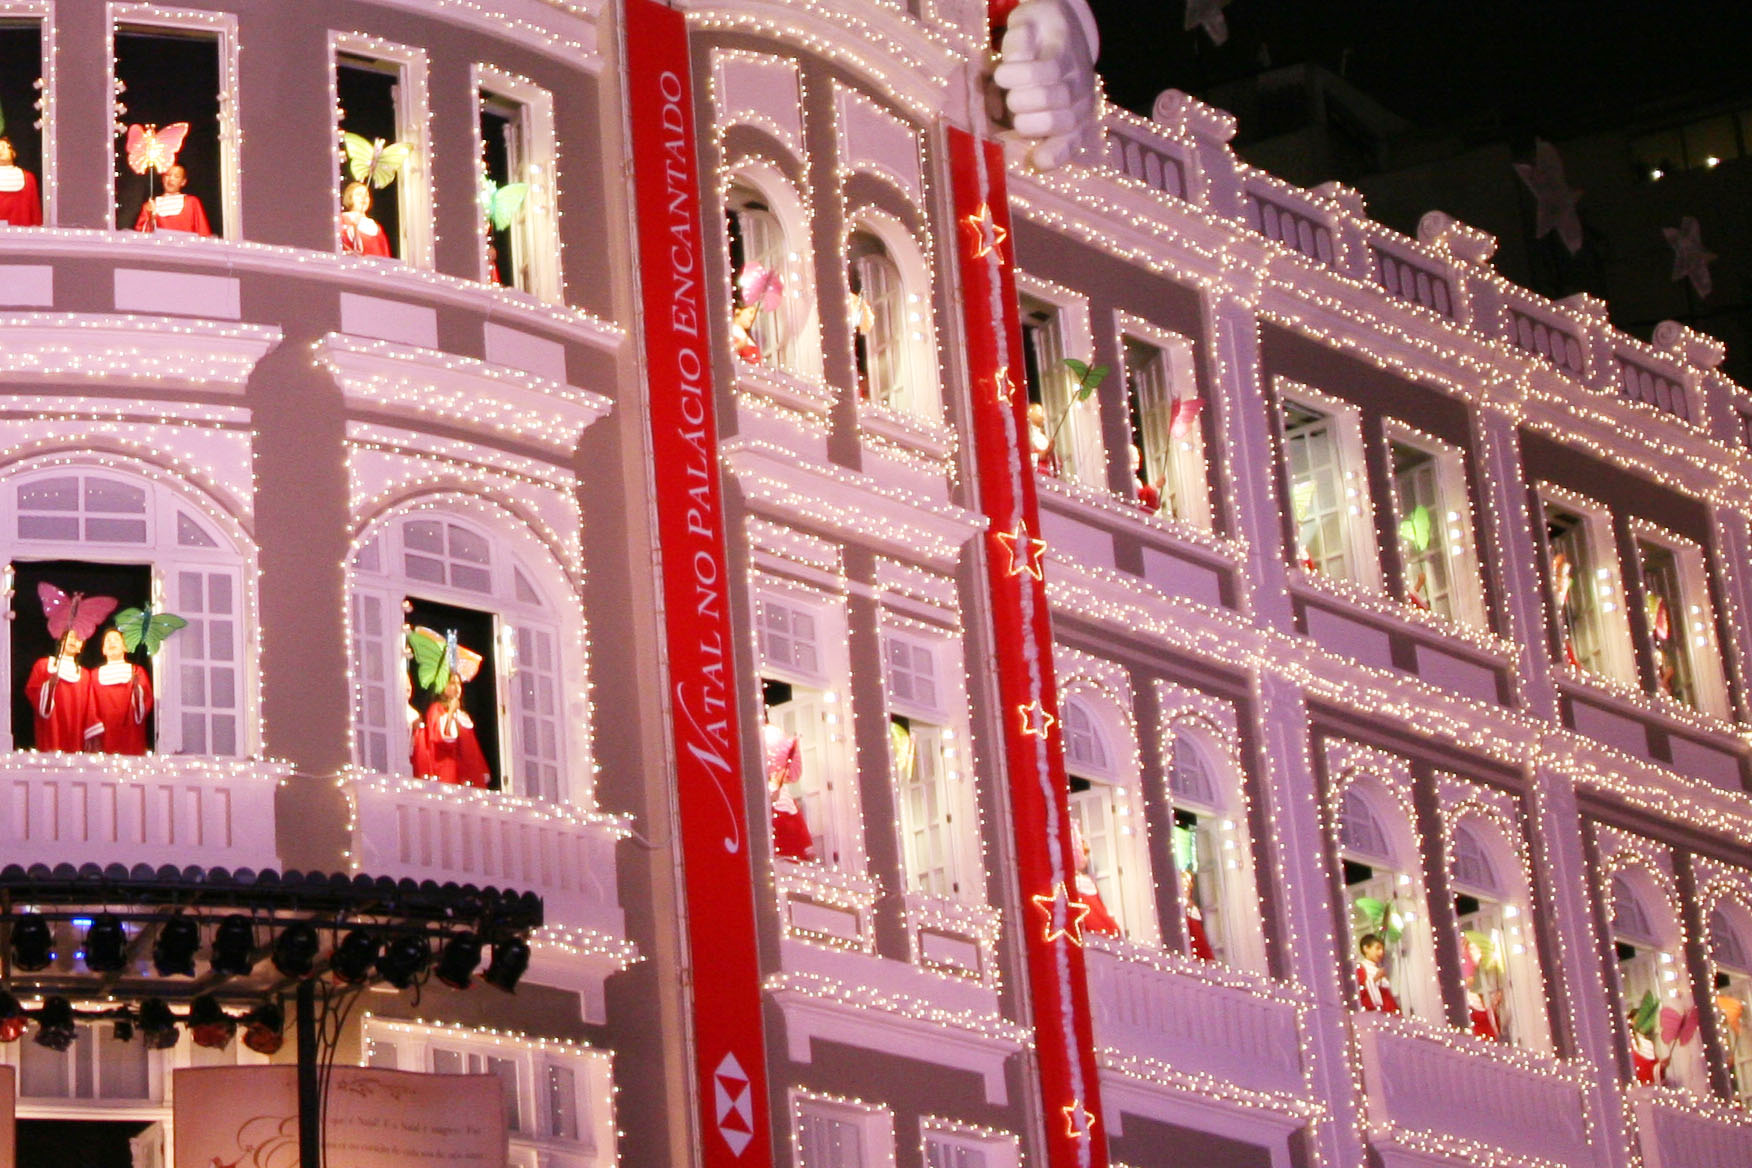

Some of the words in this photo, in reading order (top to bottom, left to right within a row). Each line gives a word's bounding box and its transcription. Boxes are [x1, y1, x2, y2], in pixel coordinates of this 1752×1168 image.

[658, 70, 698, 339] ENCANTADO
[677, 346, 714, 541] PALÁCIO
[694, 549, 721, 620] NO
[676, 628, 740, 855] NATAL
